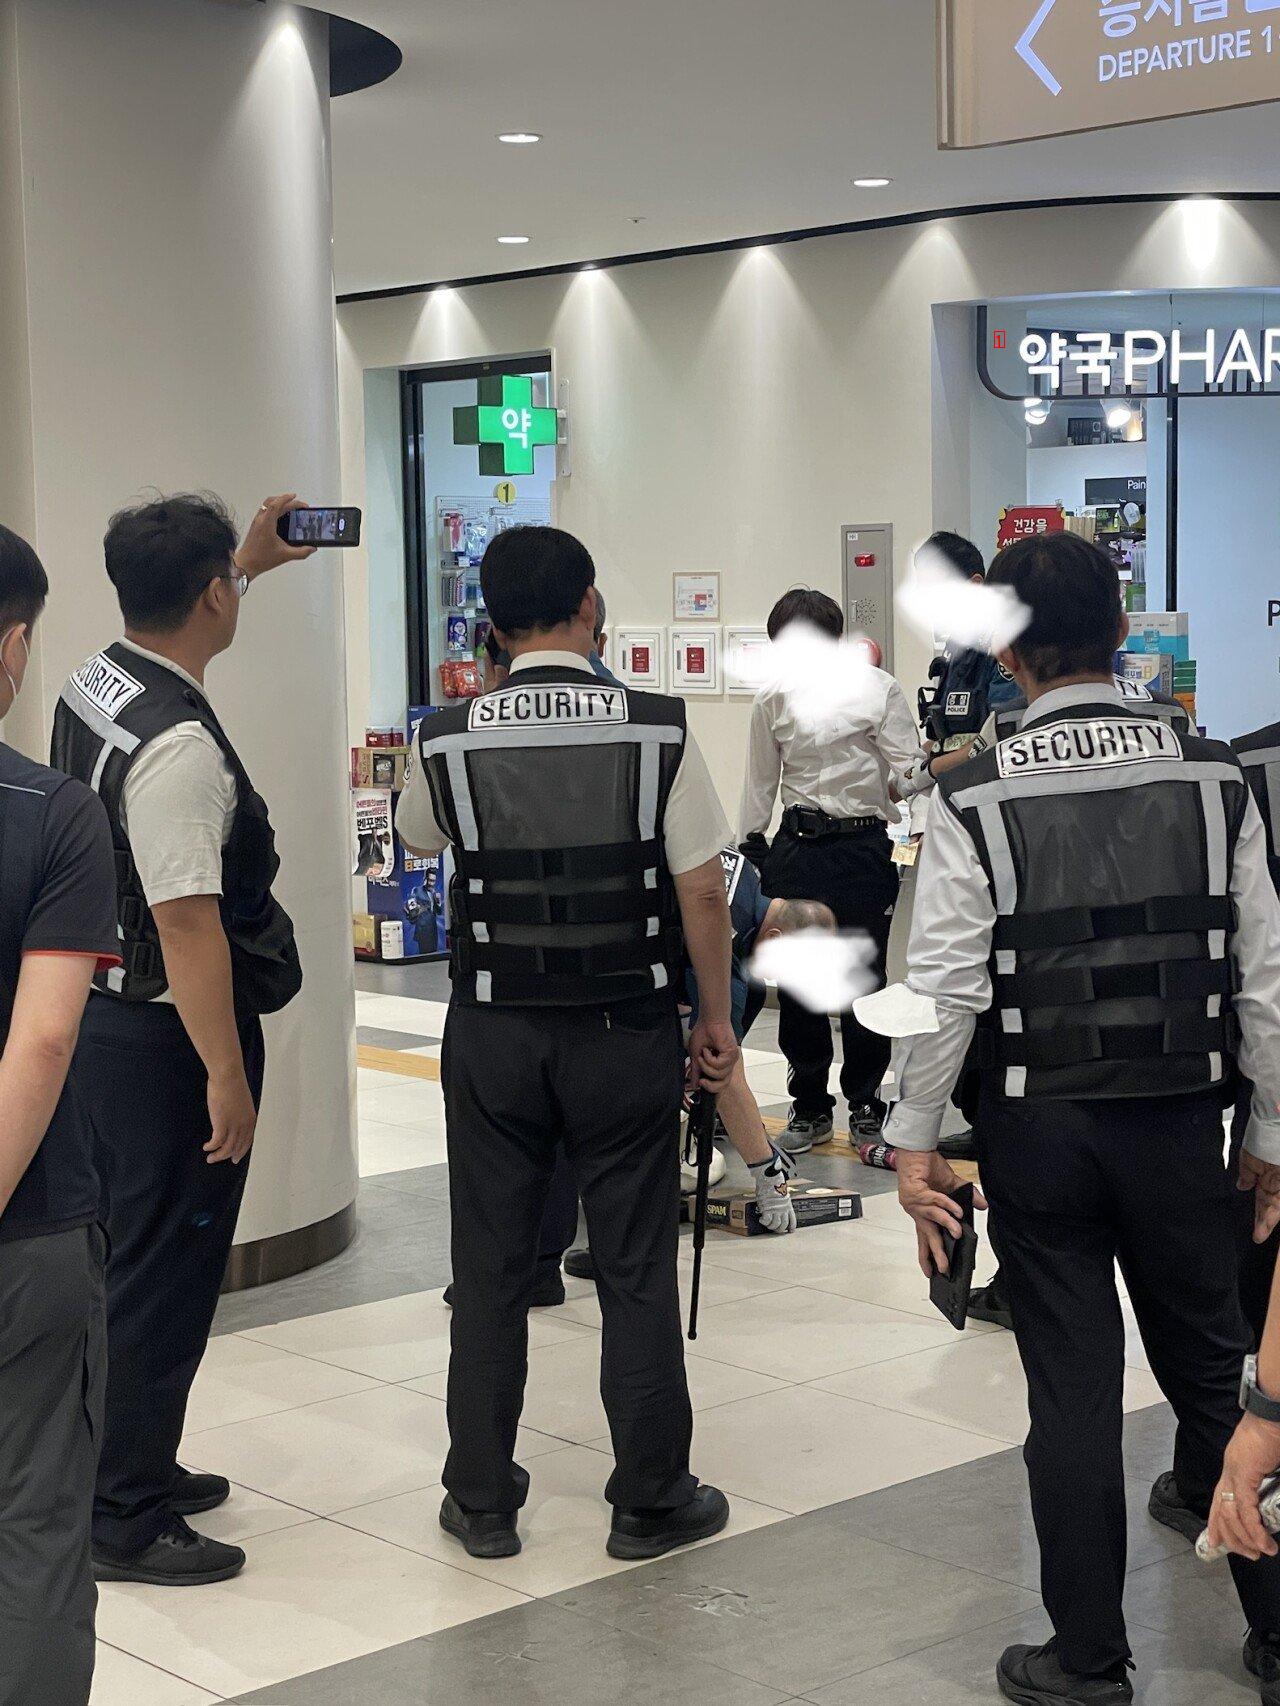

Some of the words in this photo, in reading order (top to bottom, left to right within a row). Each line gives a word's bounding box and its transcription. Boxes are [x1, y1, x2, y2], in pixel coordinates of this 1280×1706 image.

[1099, 29, 1252, 82] DEPARTURE
[501, 408, 533, 449] 약
[502, 483, 510, 503] 1
[1013, 518, 1047, 534] 건강을
[77, 660, 131, 708] CURITY
[479, 692, 615, 722] SECURITY
[1008, 725, 1165, 766] SECURITY
[707, 1204, 727, 1216] SPAM
